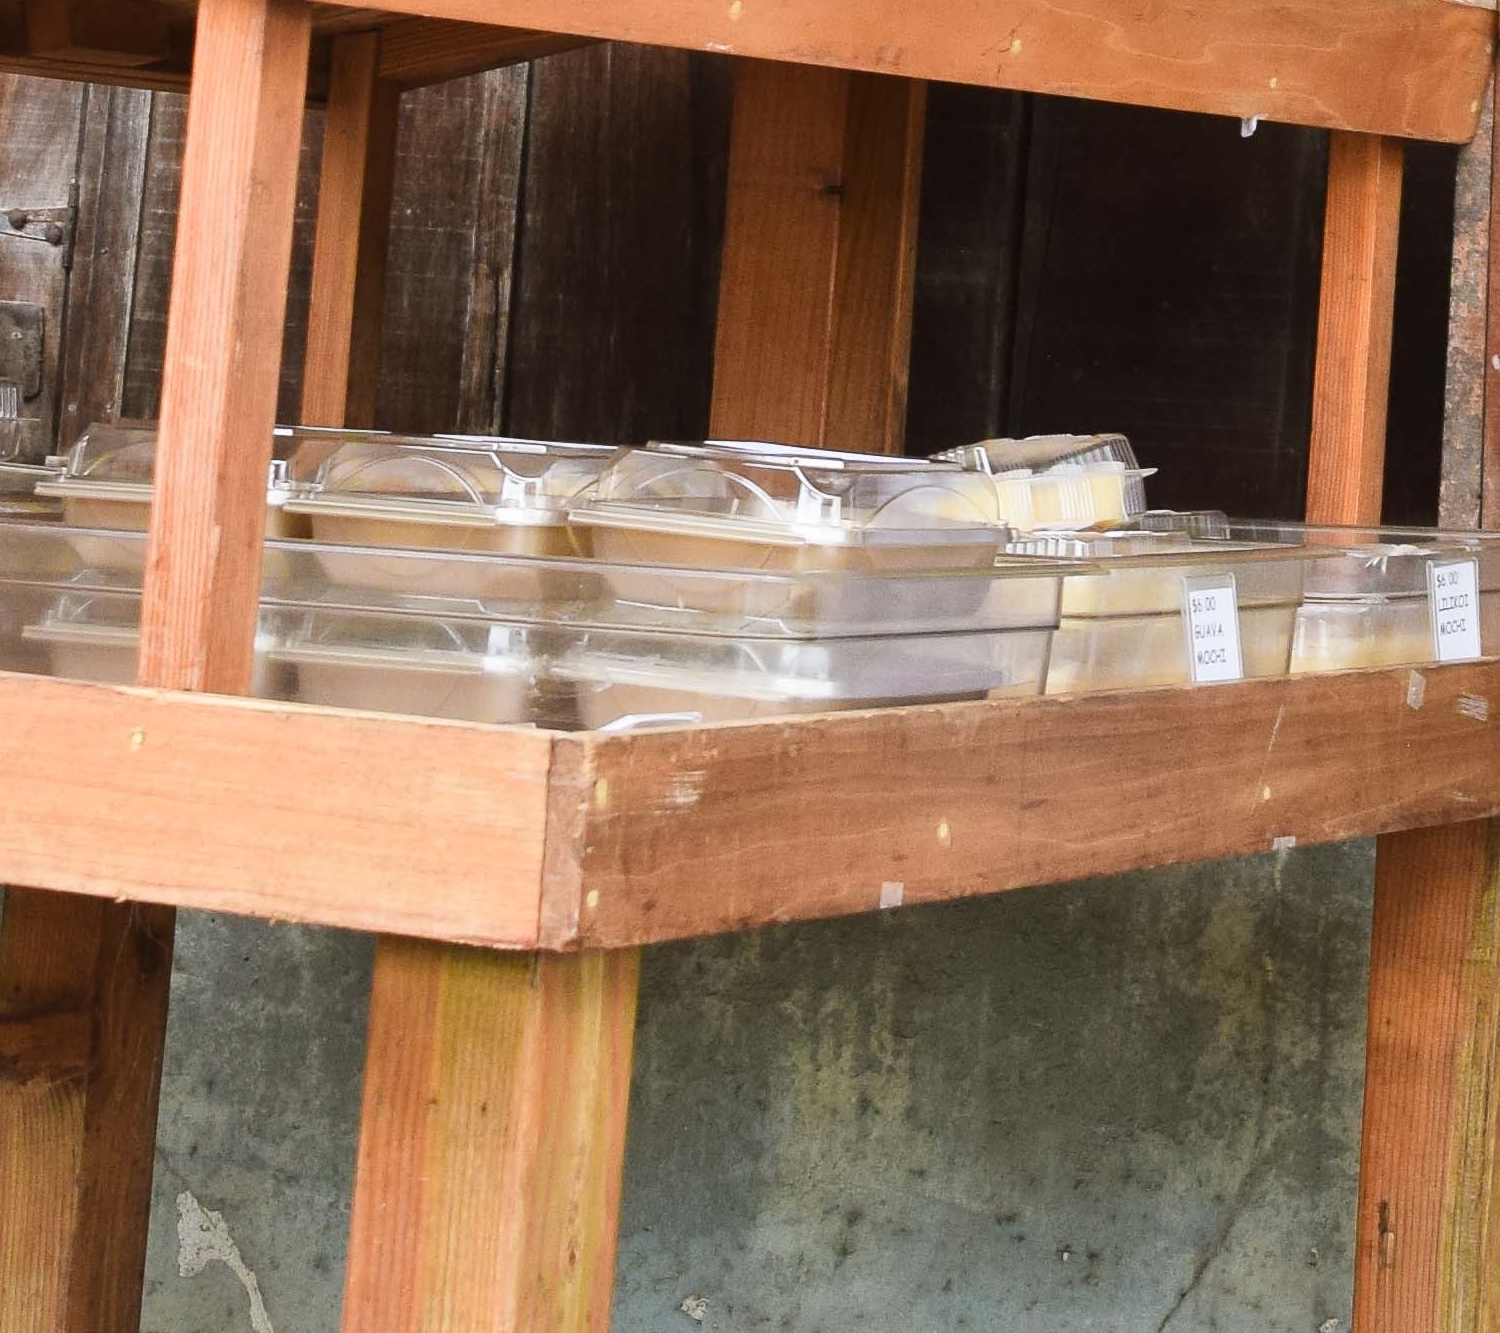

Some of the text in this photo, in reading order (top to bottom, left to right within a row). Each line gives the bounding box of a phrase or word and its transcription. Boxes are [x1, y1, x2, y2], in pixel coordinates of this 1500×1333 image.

[1195, 623, 1223, 639] GUAVA
[1440, 618, 1467, 635] MOCHI
[1198, 649, 1226, 665] MOCHI
